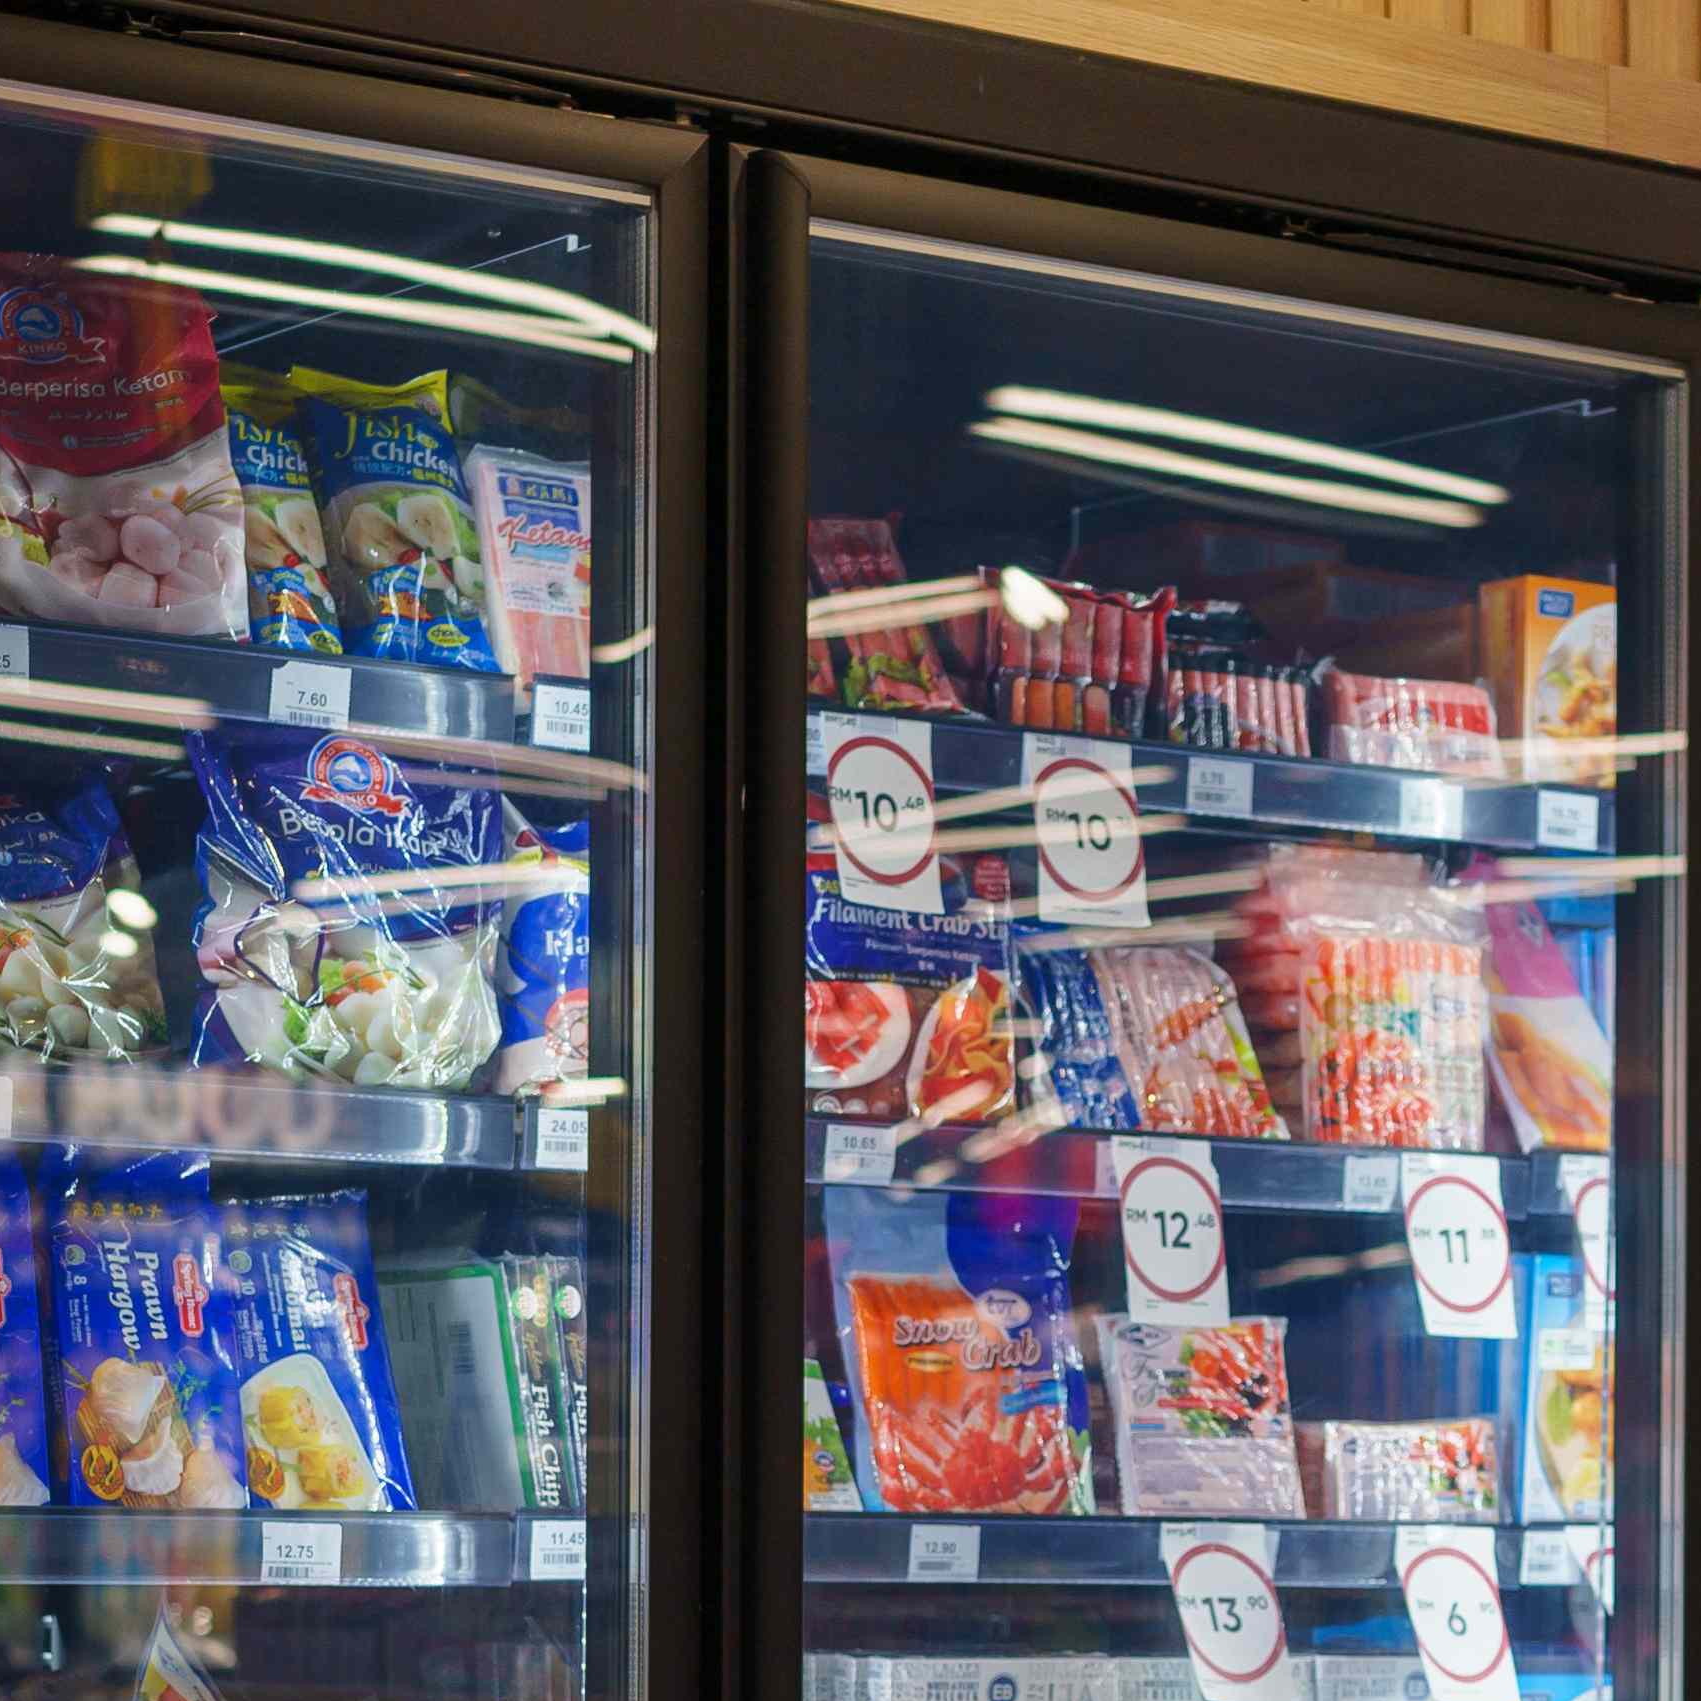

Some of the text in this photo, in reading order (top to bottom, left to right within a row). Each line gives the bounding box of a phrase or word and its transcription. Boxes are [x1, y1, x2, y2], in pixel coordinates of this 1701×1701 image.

[113, 367, 187, 396] Ketam
[297, 690, 328, 707] 7.60
[553, 701, 590, 716] 10.45
[854, 791, 898, 833] 10
[1067, 812, 1112, 852] 10
[813, 898, 970, 935] Filament Crab
[551, 1119, 589, 1134] 24.05
[1152, 1210, 1192, 1250] 12
[1438, 1228, 1471, 1265] 11
[102, 1239, 142, 1351] Hargow
[134, 1248, 170, 1341] Prawn
[893, 1316, 981, 1348] Snow
[962, 1329, 1042, 1370] Crab
[529, 1381, 564, 1508] Fish Chip
[275, 1543, 314, 1561] 12.75
[550, 1531, 586, 1547] 11.45
[1202, 1596, 1243, 1635] 13
[1447, 1602, 1468, 1636] 6
